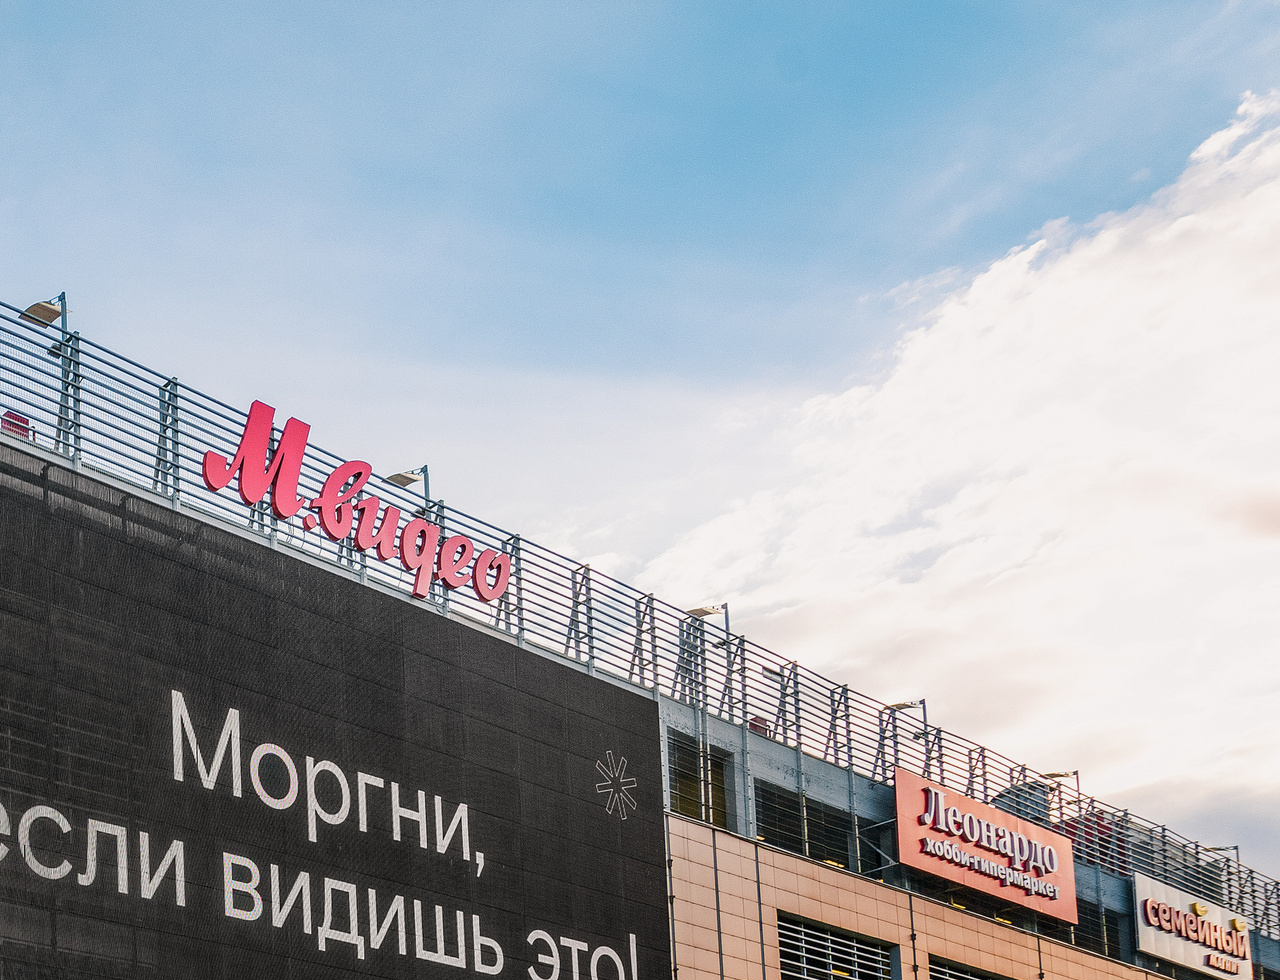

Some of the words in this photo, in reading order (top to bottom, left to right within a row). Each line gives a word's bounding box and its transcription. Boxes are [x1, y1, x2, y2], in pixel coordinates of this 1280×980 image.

[172, 690, 486, 877] Моргни,
[919, 786, 1059, 876] Леонардо
[223, 851, 505, 976] видишь
[921, 837, 1060, 900] хобби-гипермаркет
